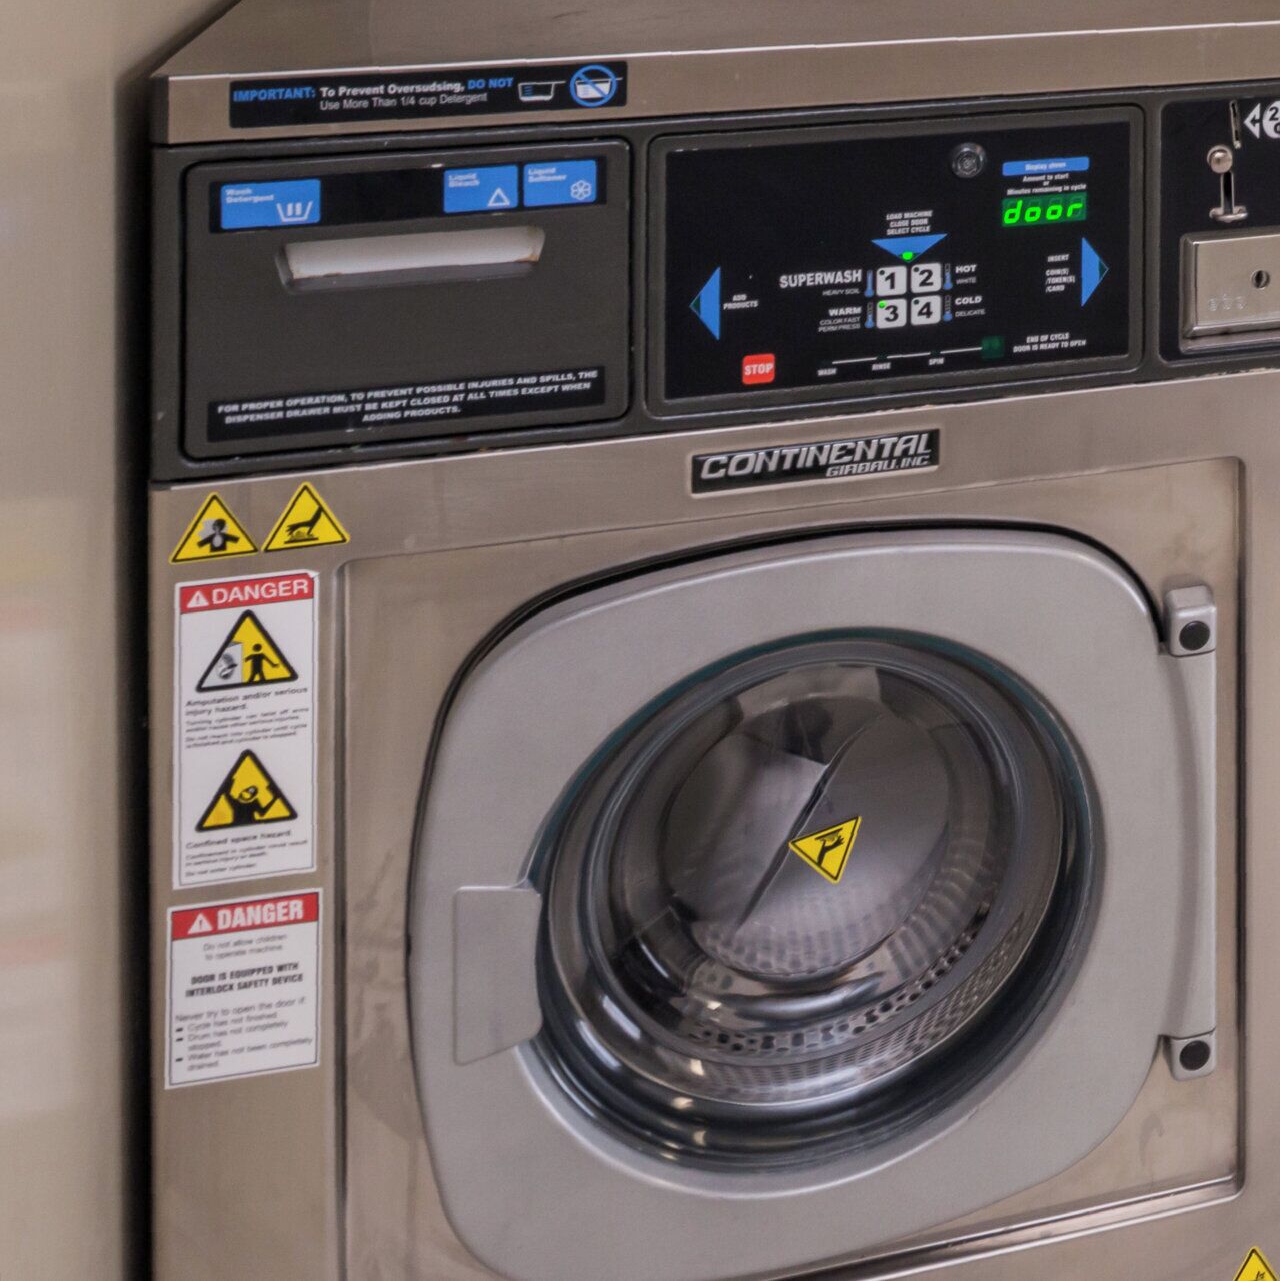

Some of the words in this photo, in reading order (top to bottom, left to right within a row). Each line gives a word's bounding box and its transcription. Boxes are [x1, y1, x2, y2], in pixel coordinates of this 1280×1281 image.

[233, 86, 316, 102] IMPORTANT:
[320, 87, 335, 98] To
[338, 84, 385, 97] Prevent
[387, 81, 465, 94] Oversudsing,
[467, 79, 485, 90] DO
[488, 77, 514, 88] NOT
[320, 100, 339, 111] Use
[343, 98, 369, 109] More
[372, 96, 397, 107] Than
[401, 95, 415, 106] 1/4
[419, 95, 437, 107] cup
[439, 92, 488, 105] Detergent
[1004, 199, 1083, 224] door
[1047, 254, 1070, 262] INSERT
[918, 269, 934, 287] 2
[955, 264, 978, 274] HOT
[779, 269, 863, 289] SUPERWASH
[884, 272, 896, 290] 1
[956, 276, 976, 285] WHITE
[955, 296, 982, 305] COLD
[828, 307, 862, 317] WARM
[884, 305, 899, 322] 3
[917, 302, 933, 319] 4
[955, 309, 985, 317] DELICATE
[744, 363, 773, 376] STOP
[218, 404, 240, 414] FOR
[241, 400, 284, 412] PROPER
[285, 393, 348, 407] OPERATION,
[350, 392, 365, 401] TO
[367, 387, 414, 399] PREVENT
[416, 382, 466, 394] POSSIBLE
[467, 378, 514, 389] INJURIES
[516, 376, 537, 385] AND
[539, 372, 576, 383] SPILLS,
[578, 370, 598, 379] THE
[224, 411, 284, 424] DISPENSER
[286, 407, 331, 418] DRAWER
[332, 404, 362, 414] MUST
[364, 402, 379, 411] BE
[381, 399, 407, 410] KEPT
[410, 395, 450, 406] CLOSED
[452, 393, 465, 402] AT
[467, 391, 486, 400] ALL
[488, 388, 519, 398] TIMES
[521, 385, 559, 396] EXCEPT
[561, 382, 591, 392] WHEN
[362, 411, 401, 423] ADDING
[403, 405, 461, 418] PRODUCTS.
[701, 433, 932, 480] CONTINENTAL
[212, 579, 309, 605] DANGER
[217, 899, 304, 930] DANGER
[191, 973, 216, 985] DOOR
[218, 972, 227, 981] IS
[229, 965, 273, 980] EQUIPPED
[276, 962, 300, 973] WITH
[237, 978, 269, 990] SAFETY
[271, 973, 303, 985] DEVICE
